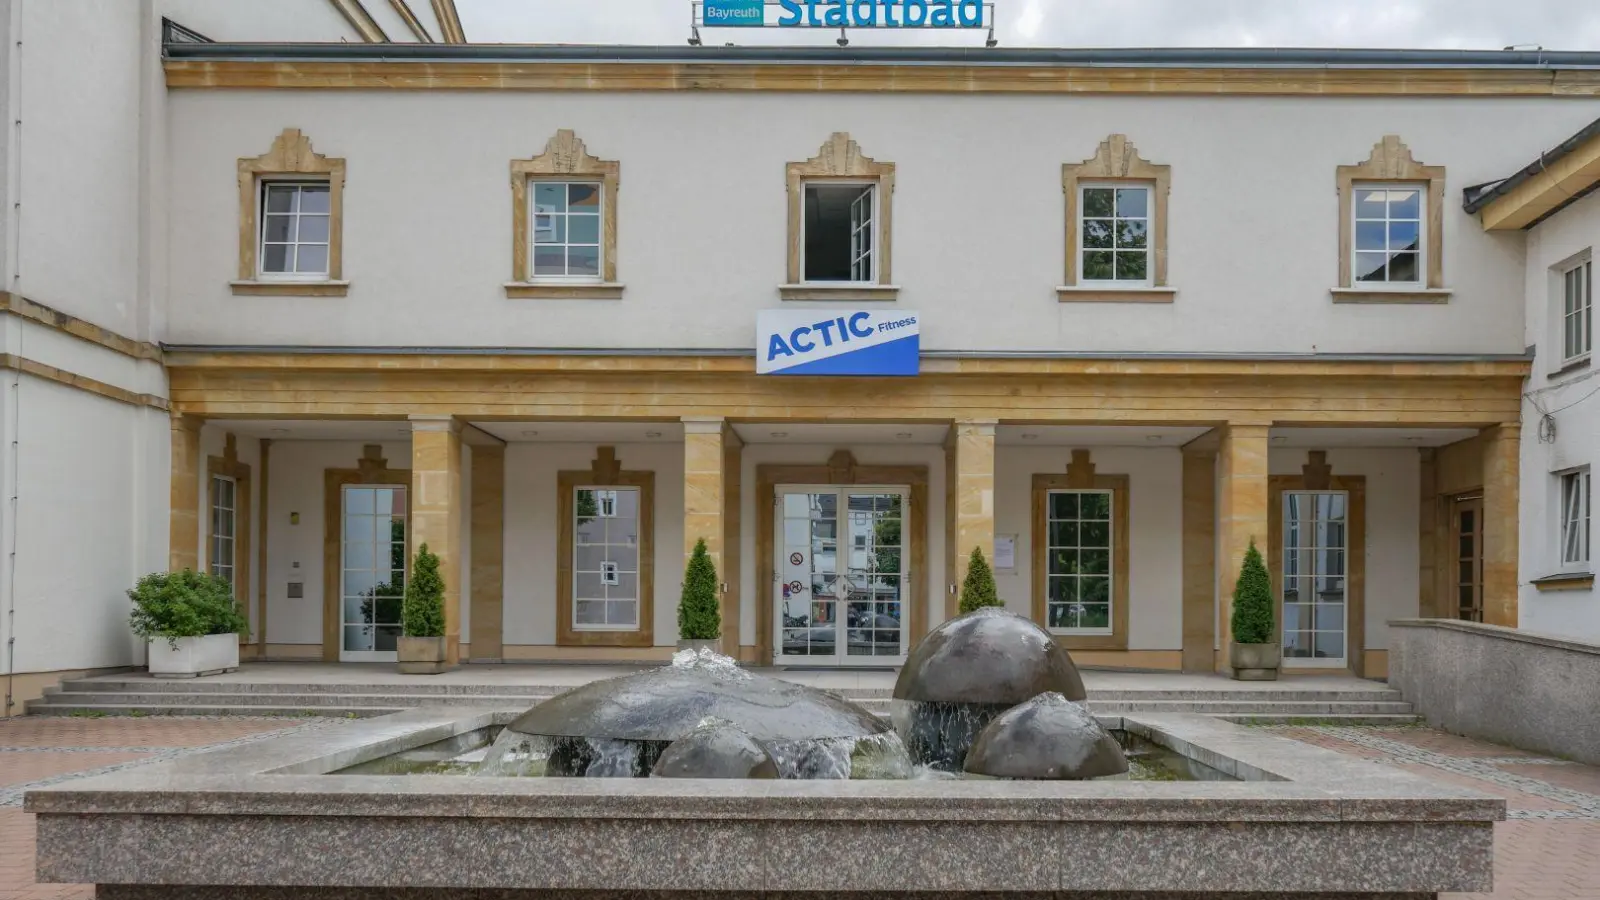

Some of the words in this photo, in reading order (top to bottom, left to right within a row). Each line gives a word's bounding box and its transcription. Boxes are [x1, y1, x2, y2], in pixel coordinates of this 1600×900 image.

[707, 6, 760, 20] Bayreuth
[779, 0, 983, 26] Stadtbad
[767, 311, 874, 361] ACTIC
[877, 316, 917, 333] Fitness
